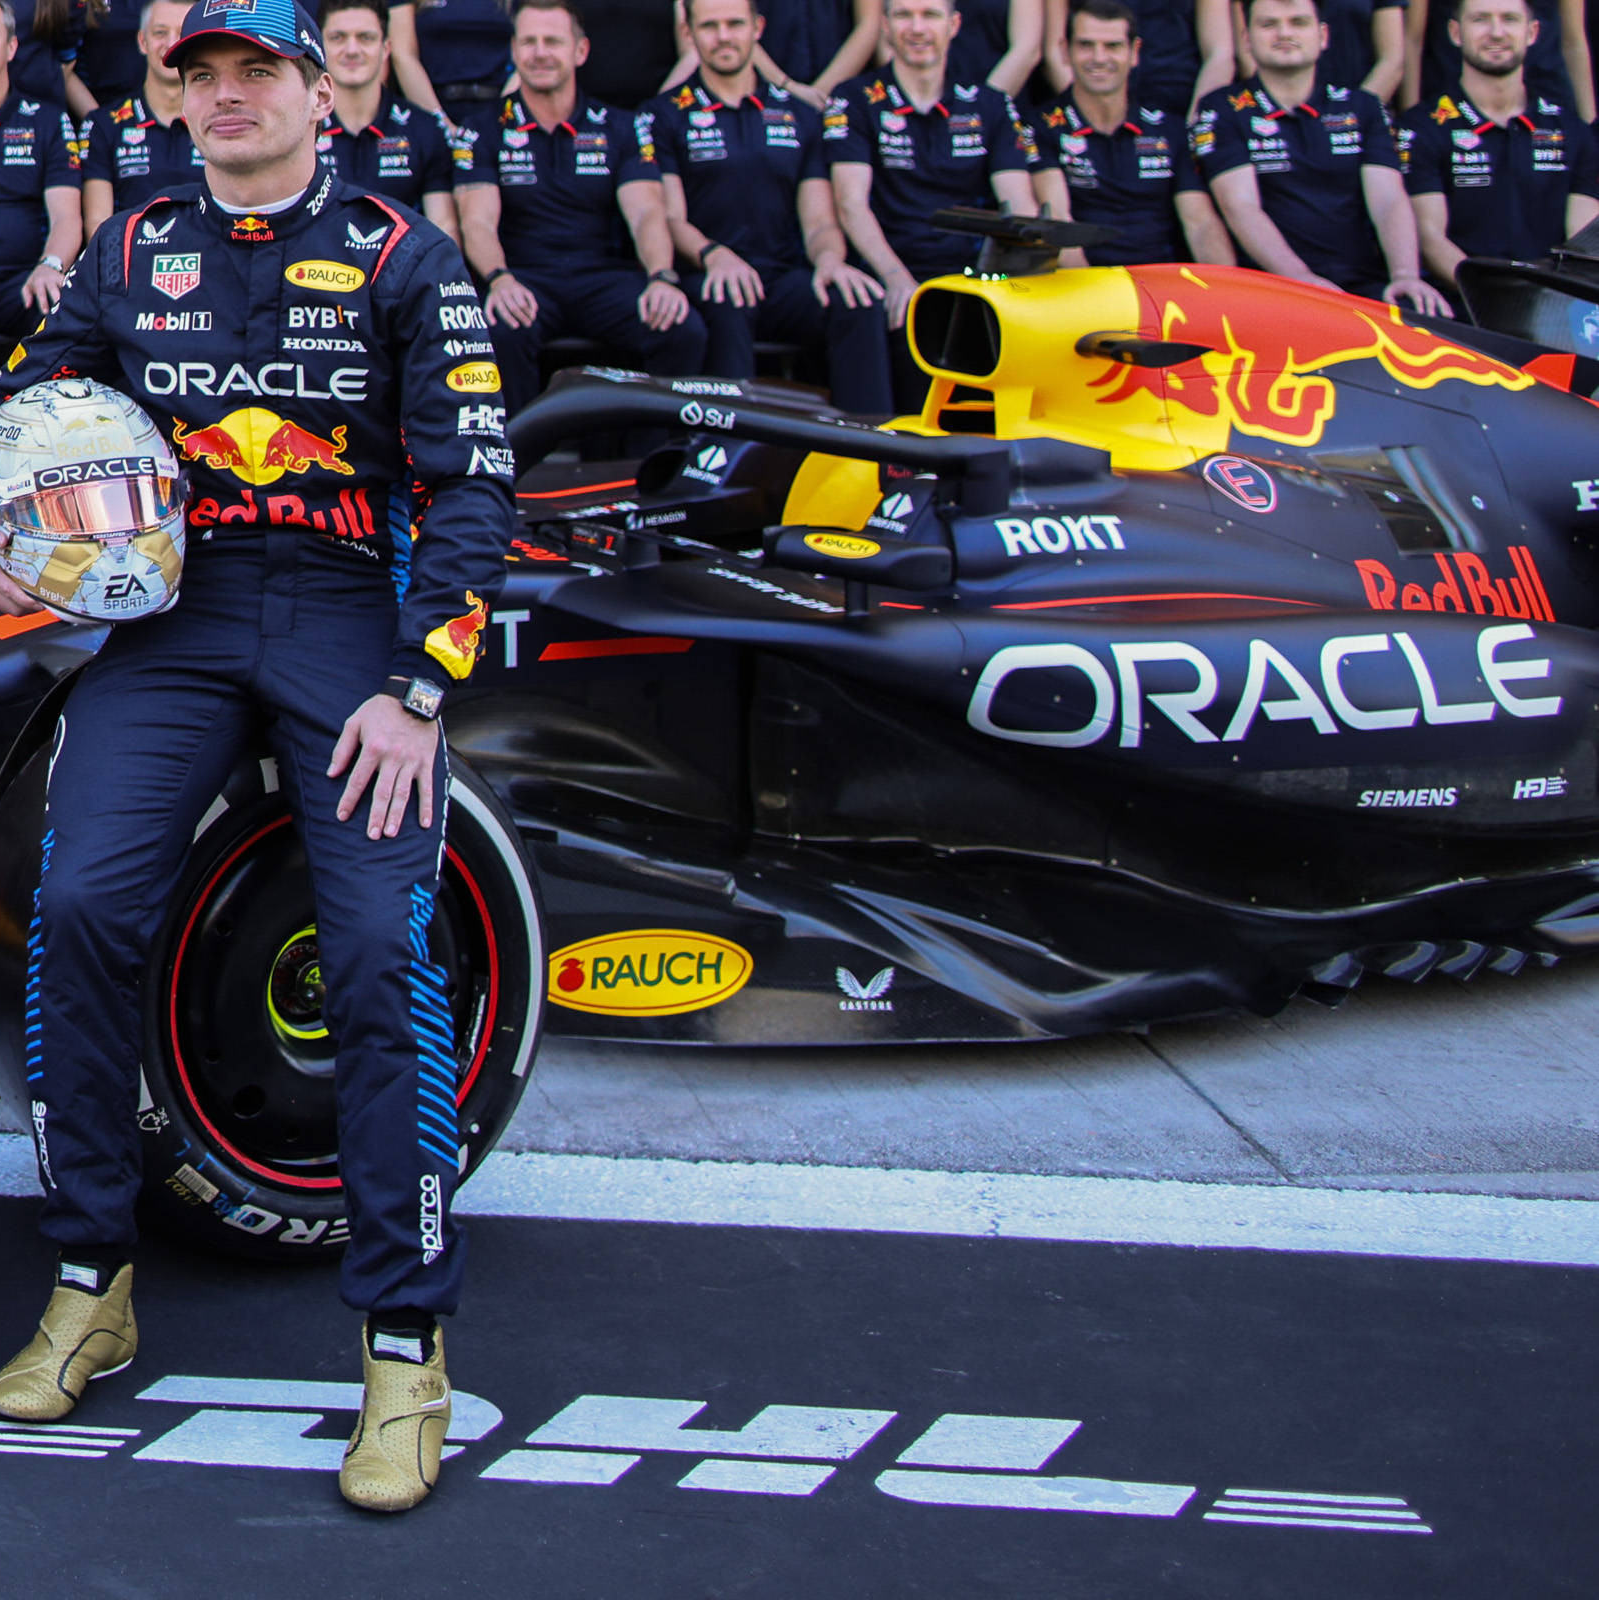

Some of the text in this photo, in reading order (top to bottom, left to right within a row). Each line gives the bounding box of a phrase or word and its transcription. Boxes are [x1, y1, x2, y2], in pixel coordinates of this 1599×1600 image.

[158, 257, 198, 271] TAG
[306, 267, 357, 285] RAUCH
[154, 273, 198, 296] HEUER
[135, 311, 191, 332] Mobil
[288, 305, 359, 329] BYBIT
[282, 337, 368, 353] HONDA
[144, 360, 369, 401] ORACLE
[704, 407, 737, 430] Sui
[38, 457, 154, 488] ORACLE
[188, 489, 259, 527] ed
[822, 537, 870, 553] RAUCH
[995, 515, 1125, 557] ROKT
[104, 573, 149, 599] EA
[103, 596, 151, 611] SPORTS
[967, 622, 1564, 748] ORACLE
[1356, 786, 1457, 808] SIEMENS
[590, 951, 723, 991] RAUCH
[222, 1203, 352, 1245] ERO
[418, 1173, 444, 1265] sparco
[133, 1374, 1196, 1518] DHL
